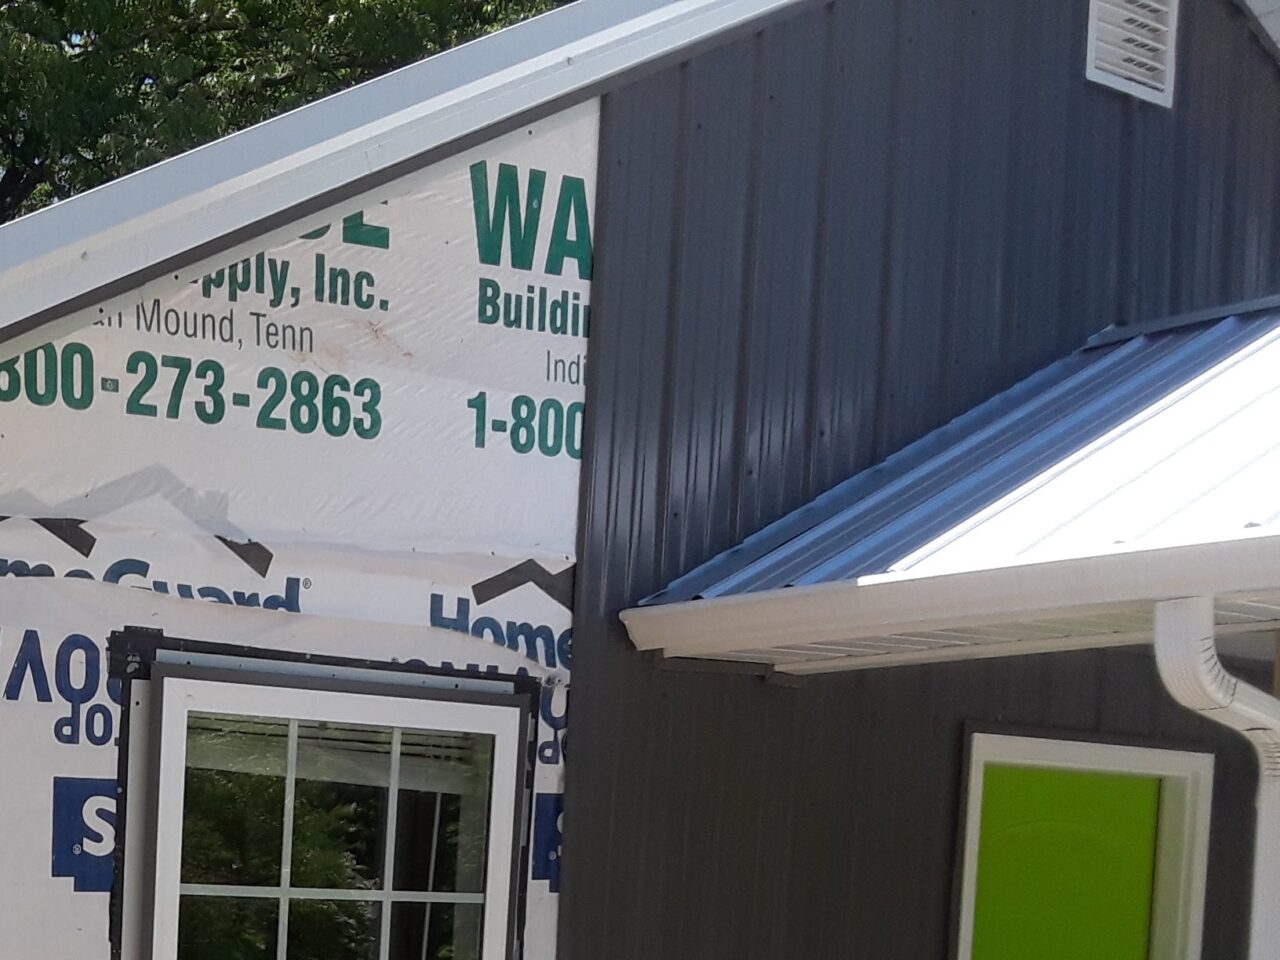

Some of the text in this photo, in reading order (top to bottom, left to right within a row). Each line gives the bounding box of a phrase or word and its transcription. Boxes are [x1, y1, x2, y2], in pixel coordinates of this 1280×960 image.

[315, 252, 400, 311] Inc.
[136, 299, 244, 350] Mound,
[249, 311, 314, 353] Tenn
